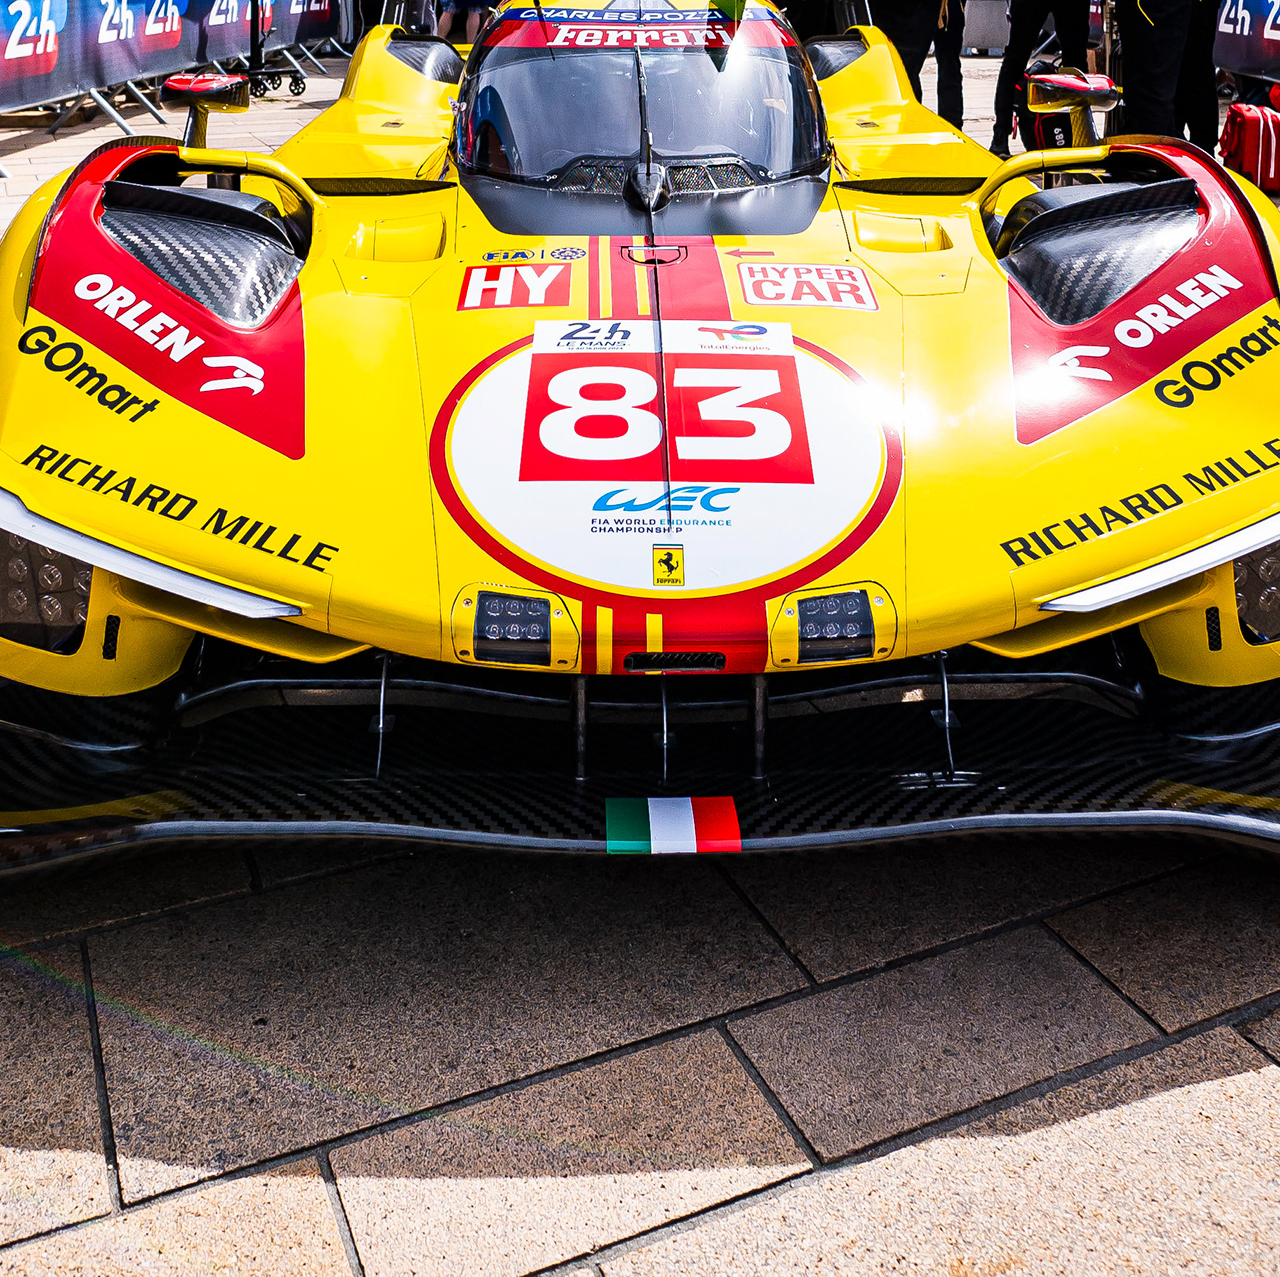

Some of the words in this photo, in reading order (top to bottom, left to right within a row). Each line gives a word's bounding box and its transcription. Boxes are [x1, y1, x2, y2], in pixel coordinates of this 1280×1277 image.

[519, 8, 637, 22] CHARLES
[640, 9, 723, 21] POZZI
[546, 24, 733, 47] Ferrari
[486, 251, 529, 261] FIA
[464, 265, 566, 307] HY
[747, 266, 858, 282] HYPER
[751, 279, 867, 305] CAR
[73, 273, 206, 363] ORLEN
[1113, 264, 1245, 349] ORLEN
[560, 321, 632, 340] 24h
[699, 343, 771, 351] TotalEnergies
[17, 325, 161, 423] GOmart
[539, 366, 793, 461] 83
[21, 444, 199, 523] RICHARD
[200, 507, 340, 573] MILLE
[592, 485, 741, 513] WEC
[590, 526, 683, 534] CHAMPIONSHP
[591, 518, 610, 526] FIA
[613, 518, 657, 526] WORLD
[659, 518, 732, 527] ENDURANCE
[999, 483, 1184, 568] RICHARD
